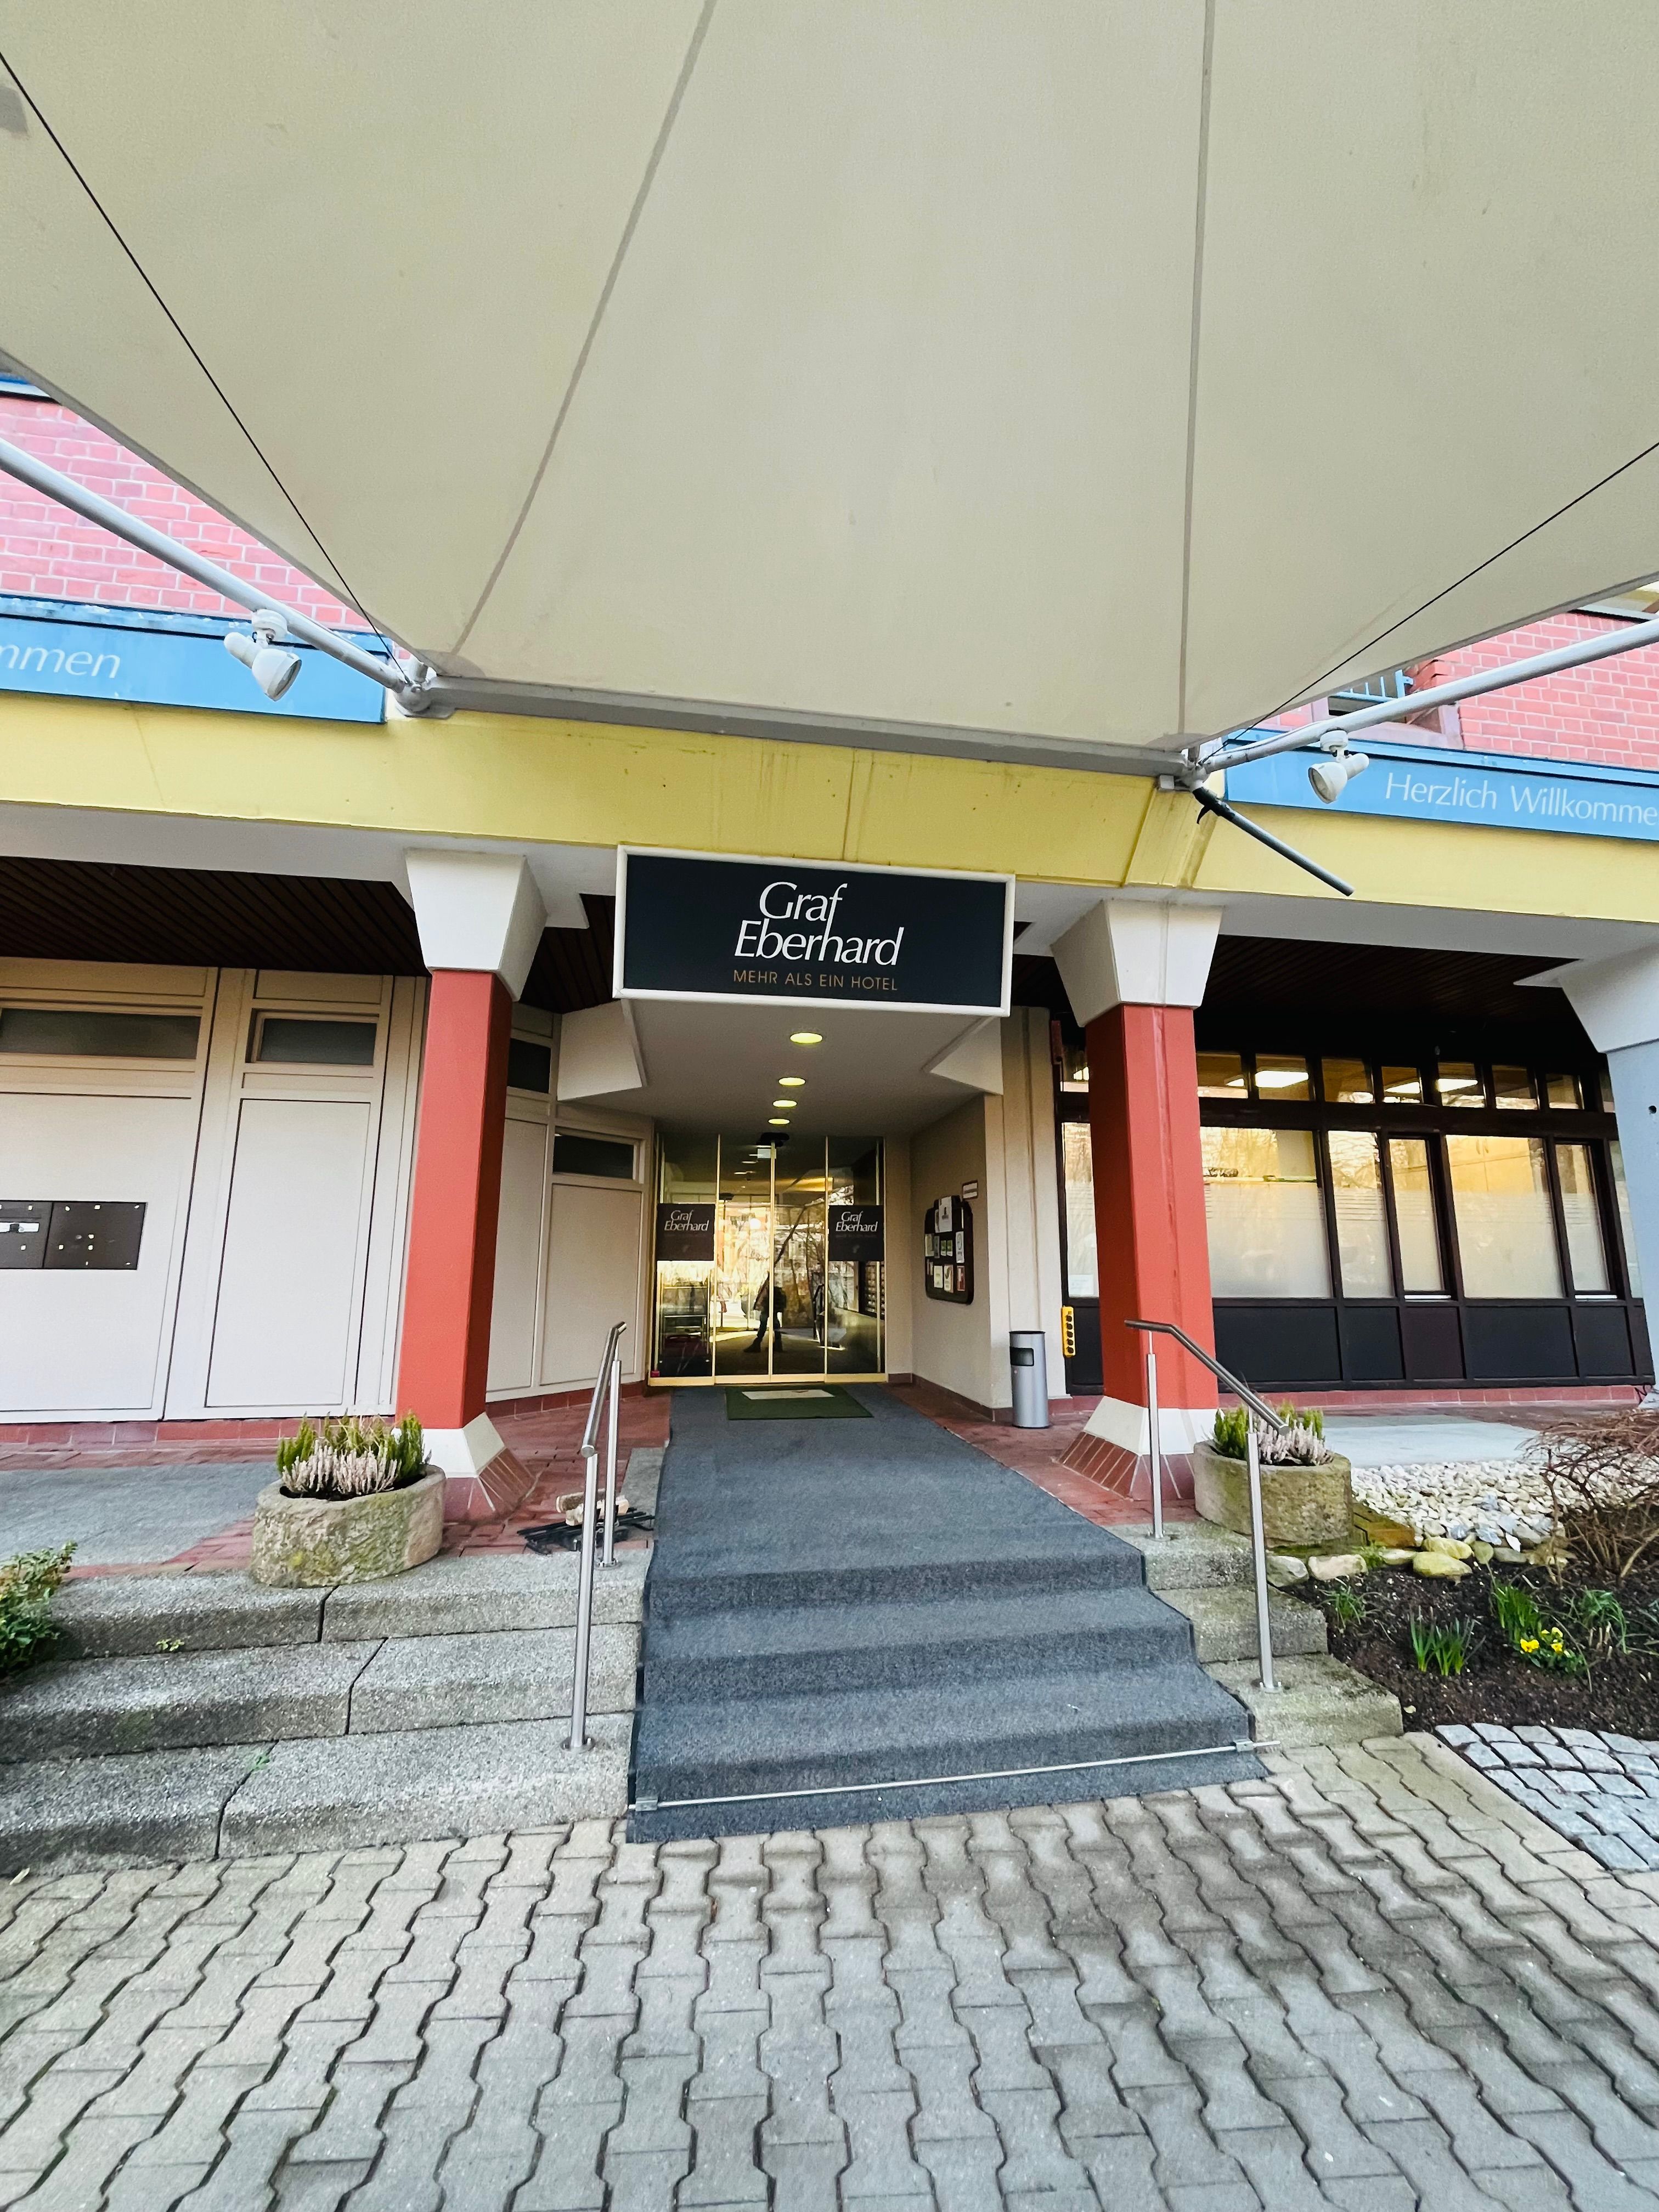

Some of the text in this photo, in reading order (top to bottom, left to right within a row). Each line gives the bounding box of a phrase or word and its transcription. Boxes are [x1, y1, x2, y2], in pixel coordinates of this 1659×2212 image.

[1385, 772, 1497, 810] Herzlich
[759, 881, 848, 922] Graf
[734, 918, 904, 966] Eberhard
[733, 969, 898, 991] MEHR ALS EIN HOTEL
[670, 1210, 694, 1221] Graf
[841, 1211, 864, 1222] Graf
[664, 1220, 709, 1231] Eberhard
[836, 1221, 878, 1232] Eberhard
